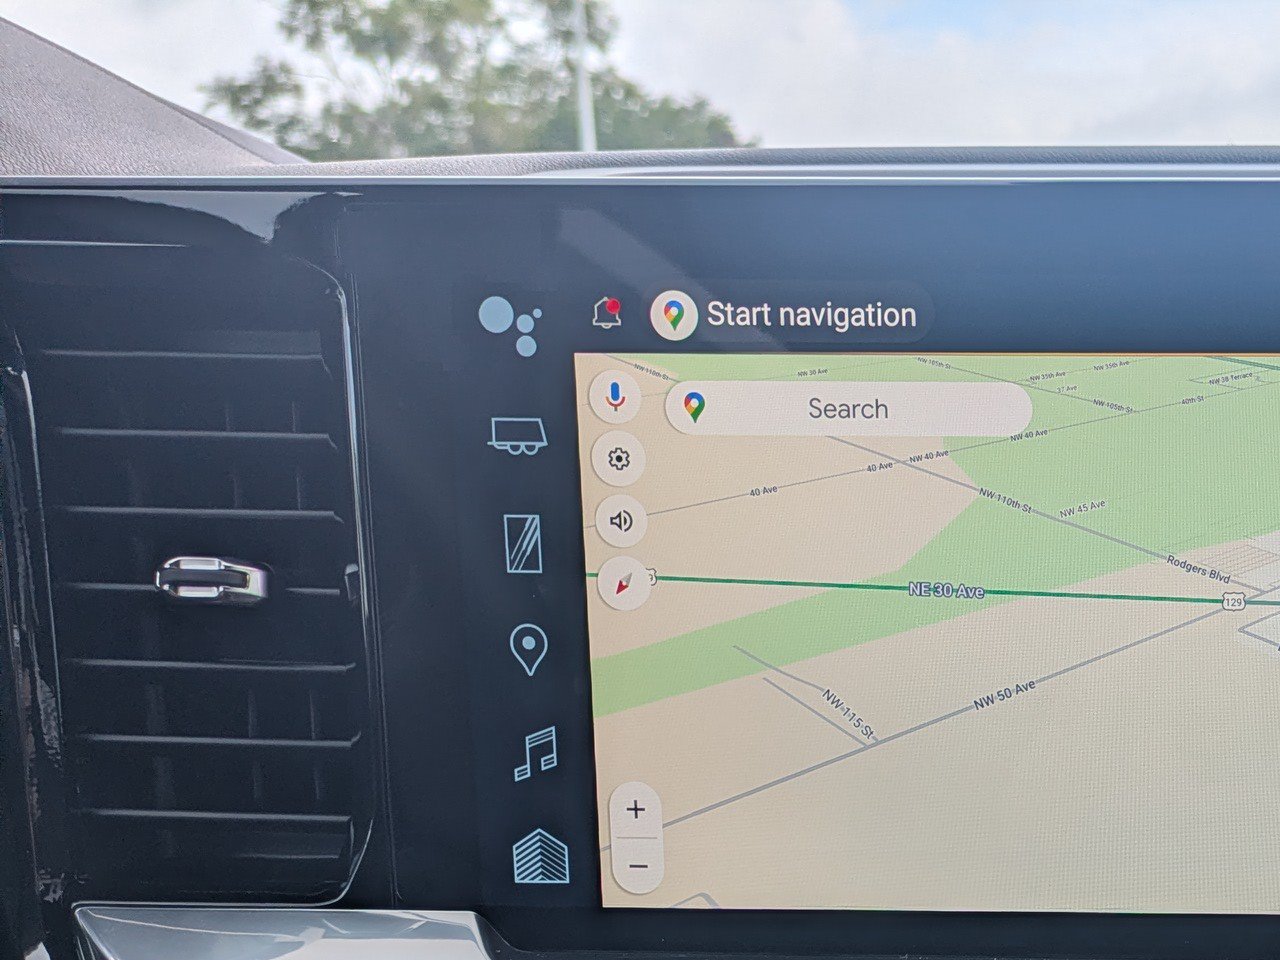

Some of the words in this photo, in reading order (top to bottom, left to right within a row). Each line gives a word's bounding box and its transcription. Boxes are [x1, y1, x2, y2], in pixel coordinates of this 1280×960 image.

[707, 302, 771, 326] Start
[781, 301, 916, 331] navigation
[809, 398, 889, 420] Search
[1010, 434, 1022, 442] NW
[1035, 428, 1048, 437] Ave
[879, 461, 893, 470] Ave
[909, 455, 922, 463] NW
[923, 452, 934, 460] 40
[935, 449, 949, 457] Ave
[750, 488, 761, 497] 40
[762, 485, 778, 494] Ave
[979, 487, 995, 500] NW
[996, 493, 1020, 511] 110th
[1021, 503, 1032, 514] St
[1060, 508, 1076, 518] NW
[1077, 504, 1088, 514] 45
[1089, 499, 1106, 511] Ave
[1167, 555, 1207, 577] Rodgers
[1208, 568, 1231, 584] Blvd
[909, 582, 930, 597] NE
[932, 583, 952, 598] 30
[956, 584, 985, 599] Ave
[1226, 598, 1242, 607] 129
[974, 695, 995, 711] NW
[997, 688, 1012, 701] 50
[1015, 679, 1036, 694] Ave
[822, 689, 844, 709] NW
[844, 707, 864, 728] 115
[861, 724, 874, 740] St
